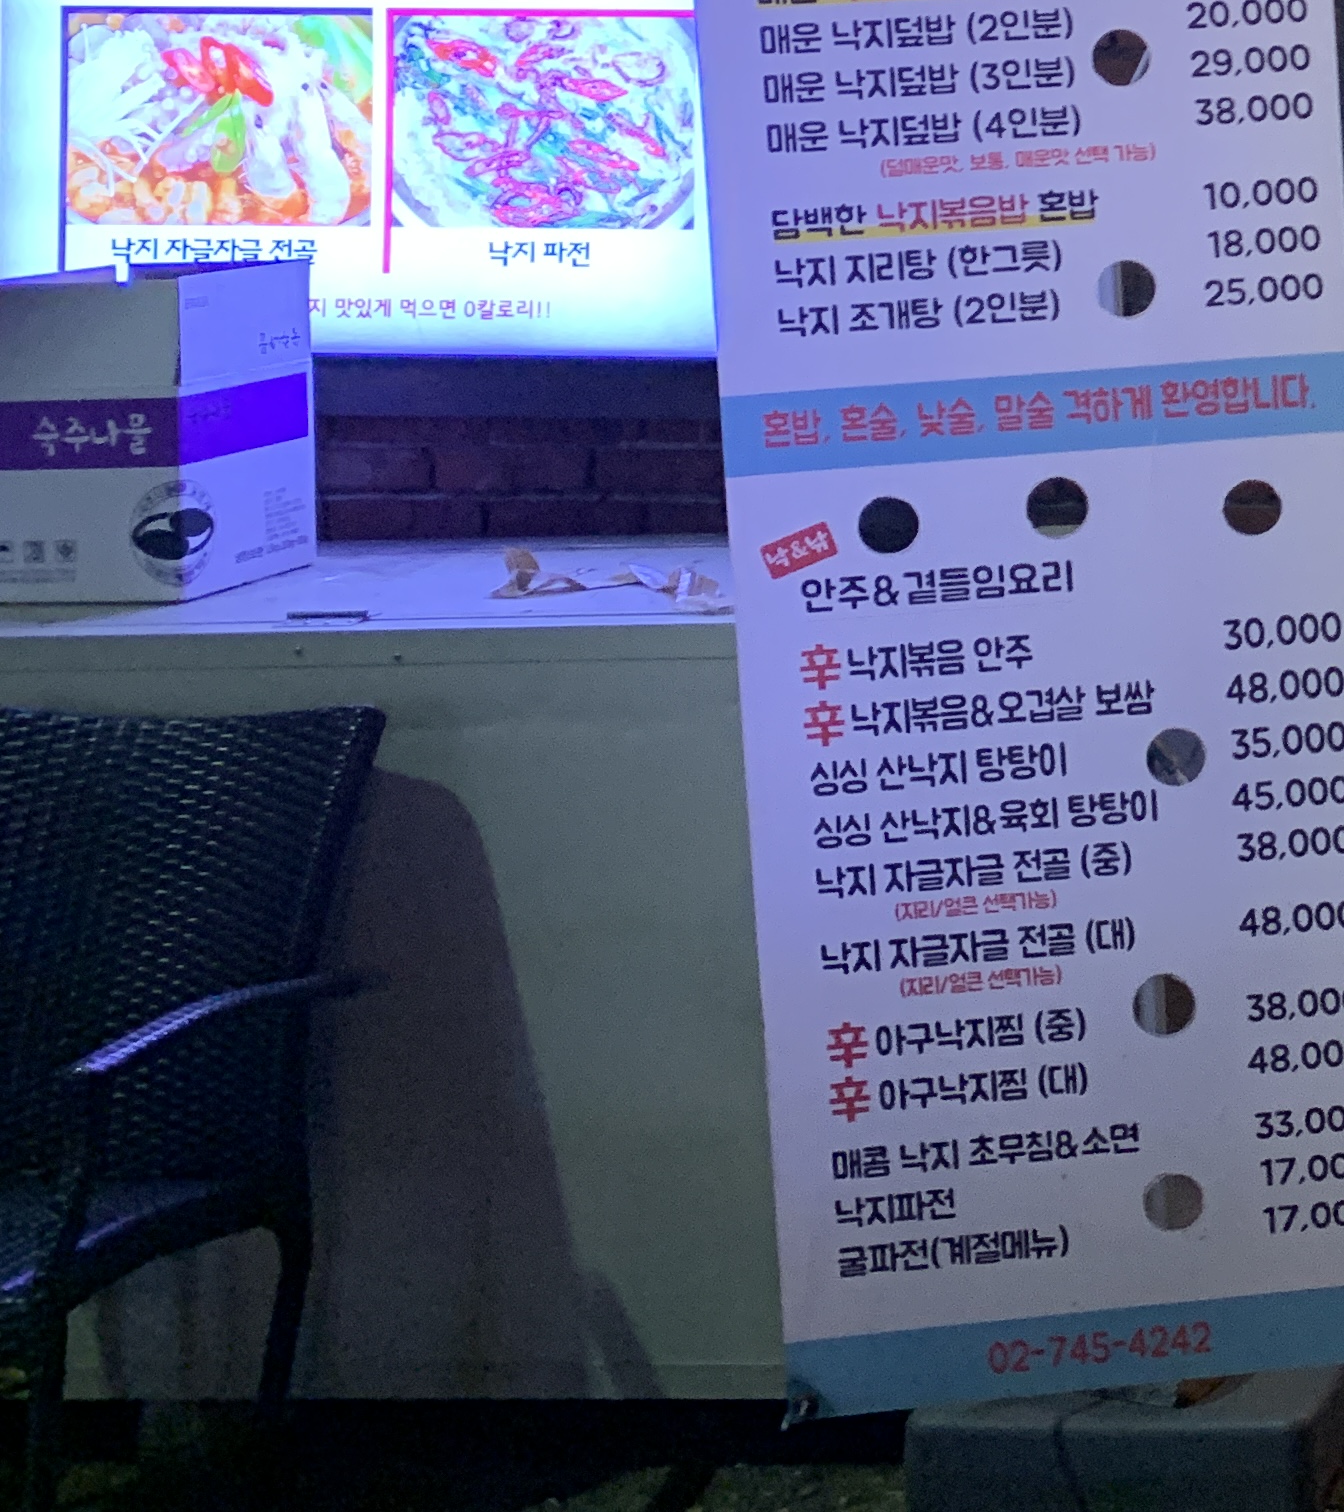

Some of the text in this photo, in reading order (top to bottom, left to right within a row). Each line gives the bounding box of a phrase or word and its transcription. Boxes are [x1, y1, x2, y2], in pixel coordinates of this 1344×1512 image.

[760, 22, 823, 55] 매운
[831, 14, 957, 51] 낙지덮밥
[967, 7, 1075, 45] (2인분)
[767, 92, 1314, 154] 매운 낙지덮밥 (4인분) 38,000
[1015, 148, 1070, 168] 매운맛
[1075, 145, 1109, 165] 선택
[1114, 142, 1157, 162] 가능)
[771, 176, 1319, 240] 담백한 낙지볶음밥 혼밥 10,000
[111, 239, 158, 264] 낙지
[489, 241, 591, 267] 낙지 파전
[775, 224, 1322, 289] 낙지 지리탕 (한그릇) 18,000
[334, 299, 551, 320] 맛있게 먹으면 0칼로리!!
[777, 273, 1325, 338] 낙지 조개탕 (2인분) 25,000
[994, 392, 1056, 432] 말술
[1064, 385, 1153, 425] 격하게
[1161, 373, 1317, 418] 환영합니다.
[32, 413, 153, 456] 숙주나물
[800, 611, 1342, 690] 辛 낙지볶음 안주 30,000
[803, 701, 845, 747] 辛
[850, 685, 1086, 738] 낙지볶음&오겹살
[1095, 680, 1155, 718] 보쌈
[811, 758, 868, 797] 싱싱
[876, 750, 968, 791] 산낙지
[976, 742, 1068, 783] 탕탕이
[815, 863, 876, 899] 낙지
[883, 852, 1005, 895] 자글자글
[1012, 845, 1072, 884] 전골
[1080, 840, 1133, 881] (중)
[826, 1022, 869, 1069] 辛
[875, 1013, 1025, 1059] 아구낙지찜
[1034, 1007, 1087, 1047] (중)
[831, 1144, 891, 1181] 매콤
[899, 1138, 960, 1175] 낙지
[834, 1187, 957, 1227] 낙지파전
[837, 1223, 1070, 1279] 굴파전(계절메뉴)
[987, 1320, 1213, 1376] 02-745-4242
